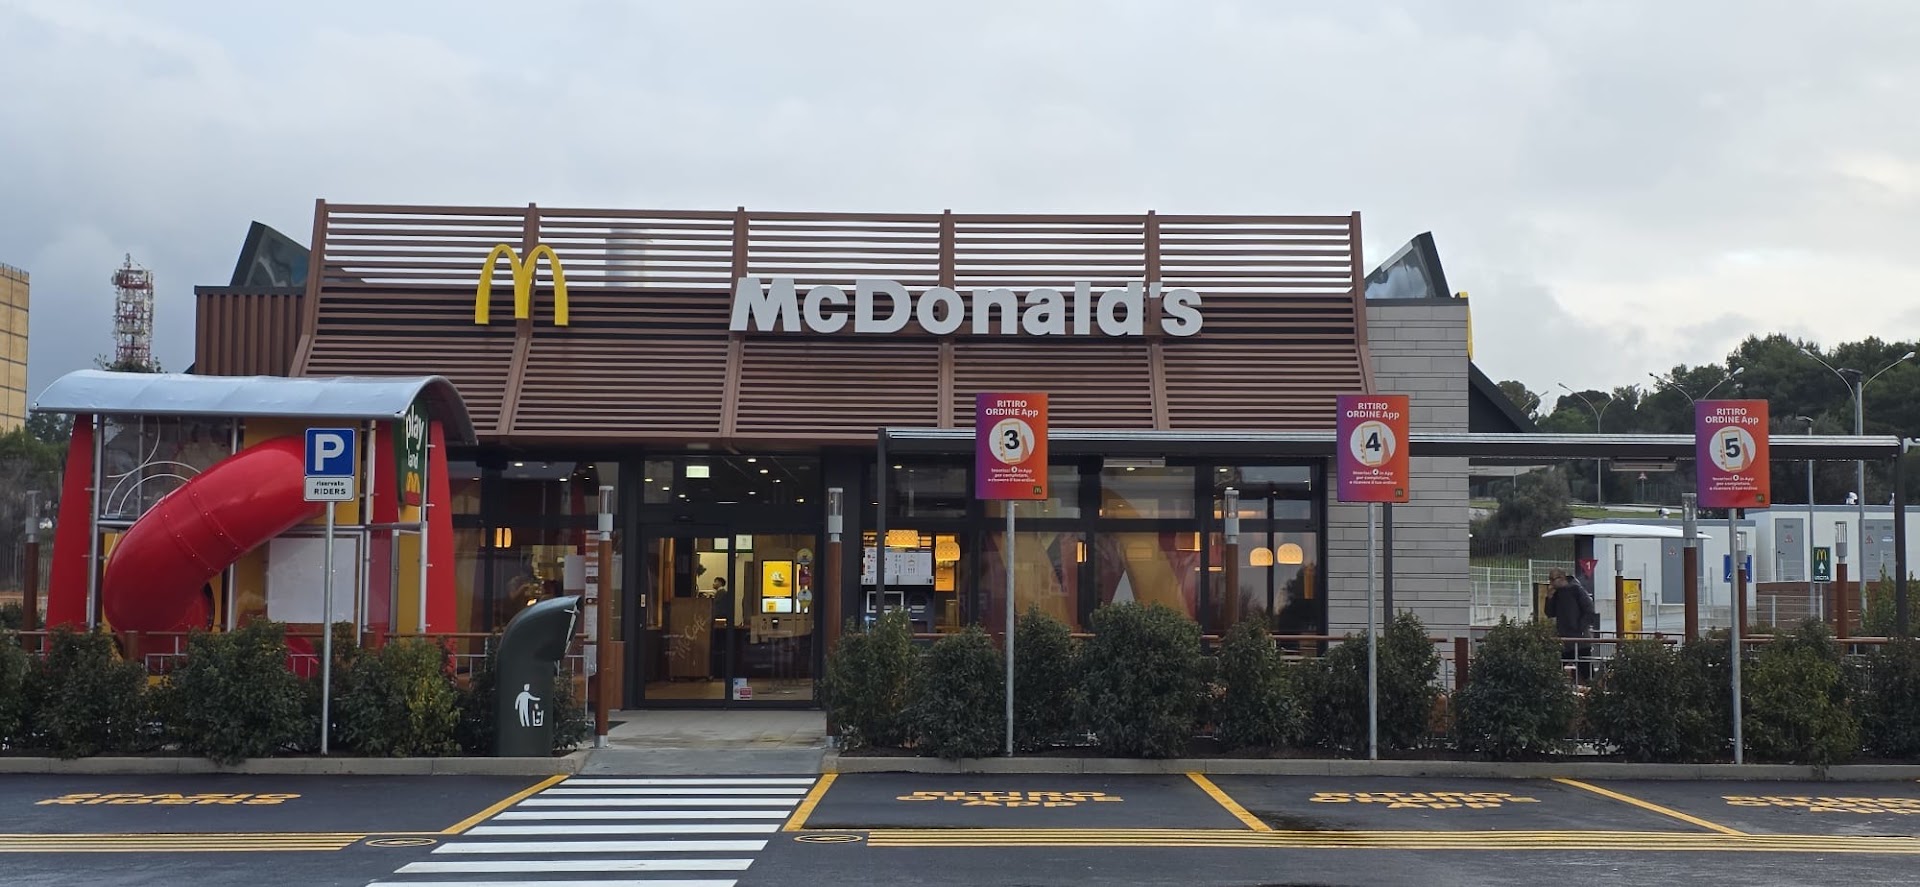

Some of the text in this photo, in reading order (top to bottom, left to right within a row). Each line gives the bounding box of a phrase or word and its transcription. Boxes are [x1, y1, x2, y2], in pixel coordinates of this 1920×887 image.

[729, 277, 1203, 336] McDonald's
[997, 400, 1027, 408] RITIRO
[1358, 402, 1388, 410] RITIRO
[985, 408, 1039, 417] ORDINE App
[1346, 410, 1400, 420] ORDINE App
[1716, 408, 1747, 416] RITIRO
[1705, 416, 1759, 425] ORDINE App
[406, 405, 424, 450] play
[1004, 429, 1020, 450] 3
[1365, 432, 1381, 452] 4
[315, 434, 345, 471] P
[1725, 437, 1741, 458] 5
[1586, 561, 1591, 570] 1
